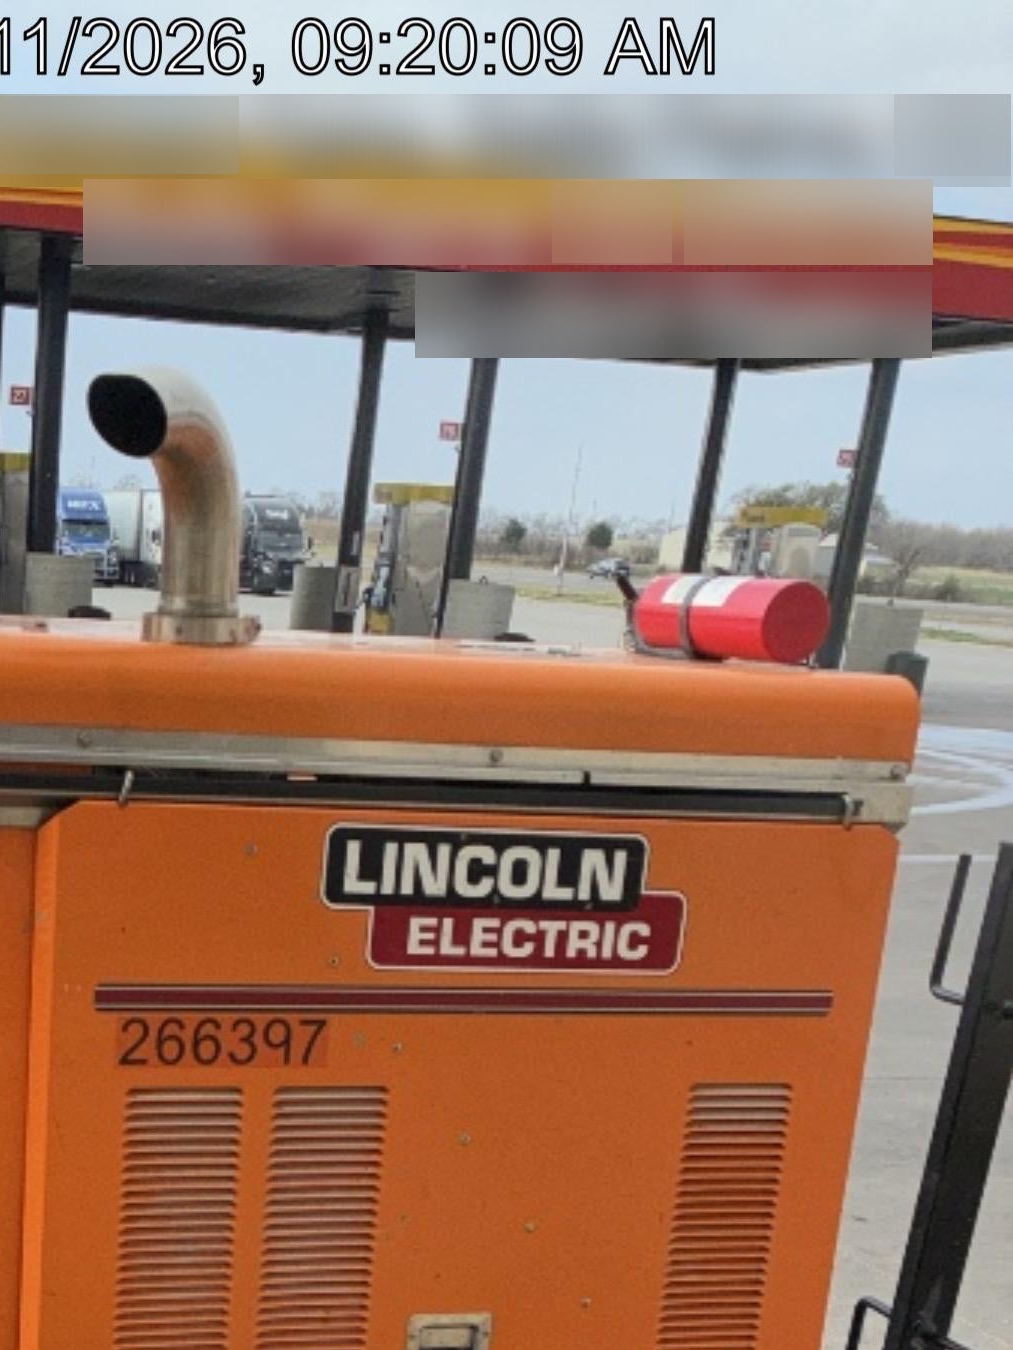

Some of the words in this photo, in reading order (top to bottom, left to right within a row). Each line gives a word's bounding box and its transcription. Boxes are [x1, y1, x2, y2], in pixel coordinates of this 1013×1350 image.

[342, 840, 628, 902] LINCOLN
[406, 916, 651, 961] ELECTRIC
[118, 1016, 328, 1067] 266397
